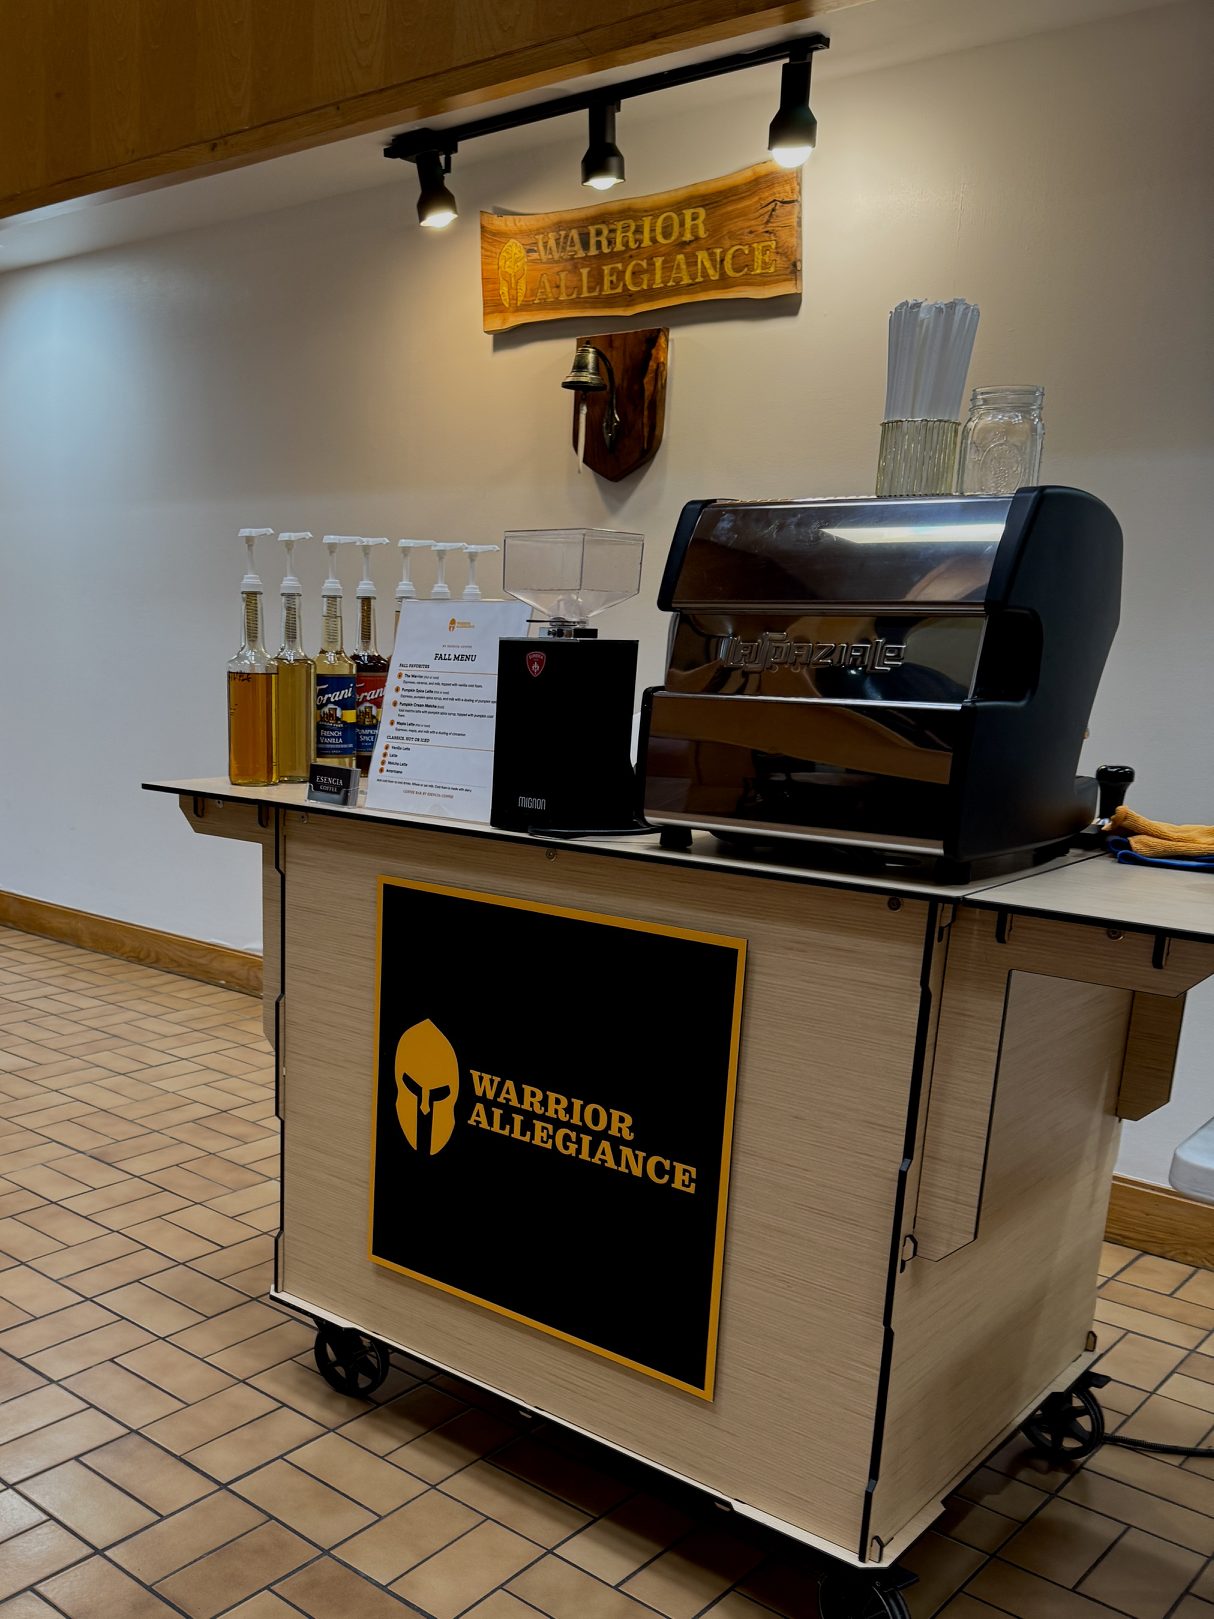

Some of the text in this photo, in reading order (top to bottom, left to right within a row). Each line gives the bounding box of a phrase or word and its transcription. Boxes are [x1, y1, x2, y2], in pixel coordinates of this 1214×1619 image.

[534, 207, 708, 263] WARRIOR
[533, 240, 777, 303] ALLEGIANCE
[434, 653, 477, 662] FALL MENU
[316, 683, 353, 705] Torani
[316, 775, 343, 786] ESENCIA
[470, 1069, 635, 1141] WARRIOR
[468, 1102, 697, 1194] ALLEGIANCE
